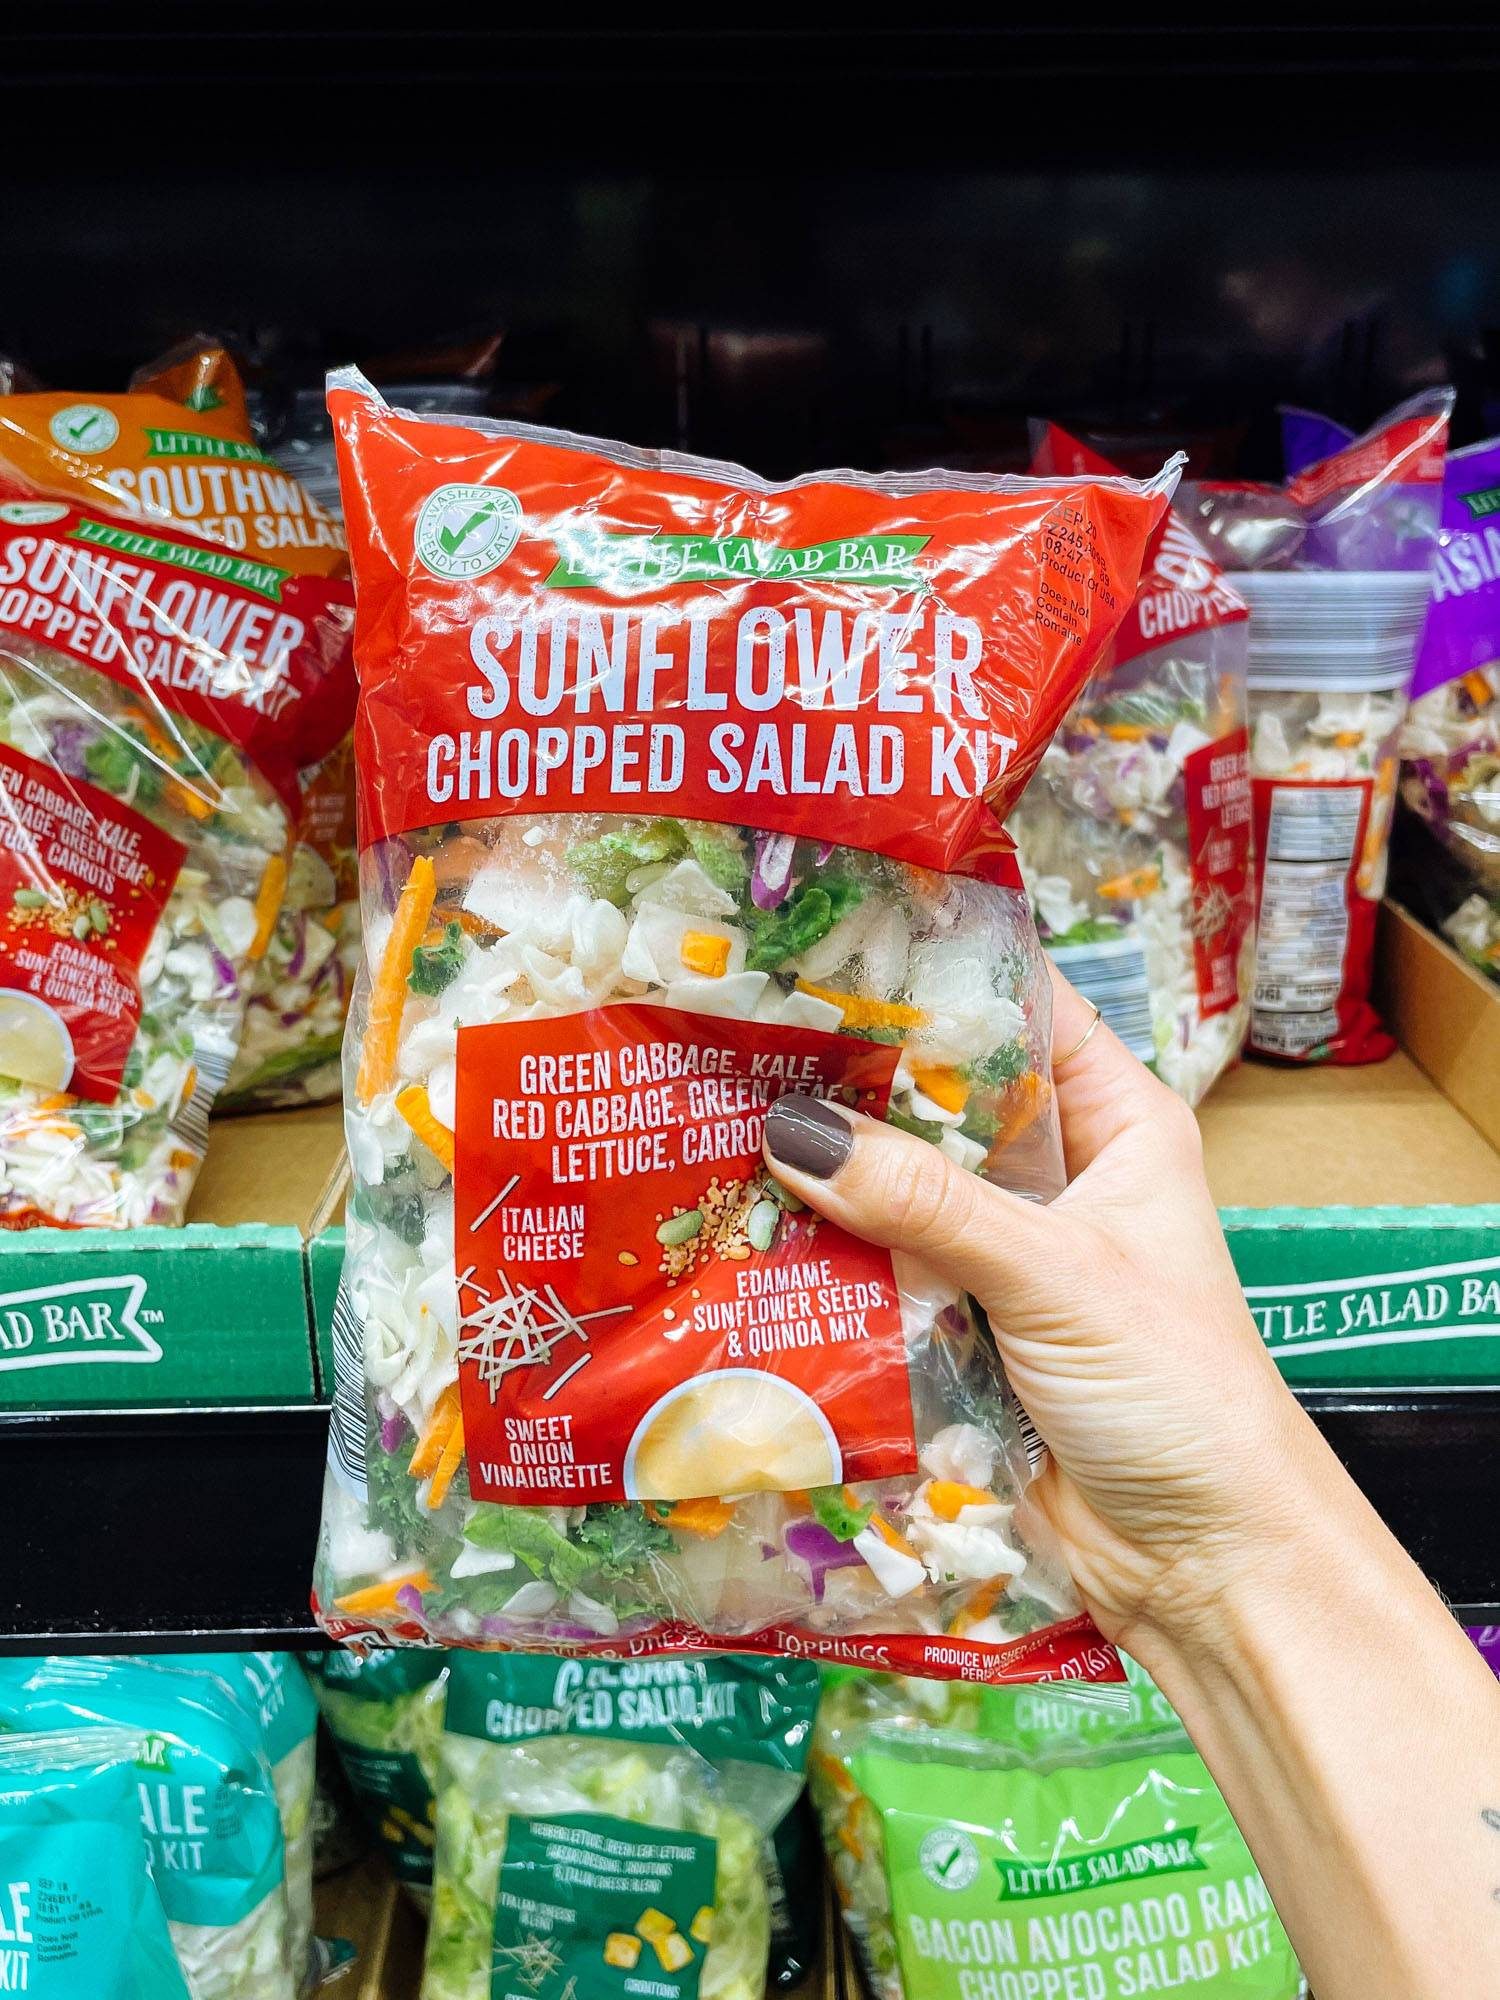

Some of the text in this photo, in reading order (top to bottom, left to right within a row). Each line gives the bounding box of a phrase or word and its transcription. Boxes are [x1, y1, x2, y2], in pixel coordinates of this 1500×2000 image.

[426, 489, 492, 519] WASHED
[80, 523, 158, 558] LITTLE
[164, 545, 233, 576] SALAD
[234, 562, 280, 594] BAR
[422, 531, 511, 572] READY TO EAT
[708, 537, 824, 575] SALAD
[838, 543, 908, 573] BAR
[1040, 552, 1086, 585] Product
[0, 535, 306, 678] SUNFLOWER
[1036, 596, 1078, 628] Contain
[1040, 582, 1090, 620] Does Not
[1034, 610, 1083, 646] Romaine
[466, 605, 991, 722] SUNFLOWER
[426, 723, 1018, 804] CHOPPED SALAD KIT
[97, 817, 143, 859] KALE,
[519, 1041, 824, 1096] GREEN CABBAGE, KALE,
[493, 1097, 545, 1140] RED
[554, 1084, 685, 1139] CABBAGE,
[687, 1077, 769, 1121] GREEN
[551, 1131, 676, 1184] LETTUCE,
[501, 1204, 585, 1235] ITALIAN
[502, 1233, 585, 1262] CHEESE
[736, 1260, 841, 1299] EDAMAME,
[40, 1303, 126, 1343] BAR
[139, 1310, 165, 1324] TM
[693, 1281, 890, 1334] SUNFLOWER SEEDS,
[1335, 1284, 1449, 1336] SALAD
[727, 1312, 870, 1358] & QUINOA MIX
[505, 1415, 573, 1443] SWEET
[509, 1441, 575, 1466] ONION
[480, 1462, 613, 1489] VINAIGRETTE
[775, 1629, 889, 1665] TOPPINGS
[924, 1646, 980, 1668] PRODUCE
[160, 1840, 204, 1871] KIT
[1007, 1863, 1082, 1894] LITTLE
[1086, 1845, 1152, 1884] SALAD
[908, 1912, 1019, 1966] BACON
[1027, 1892, 1191, 1963] AVOCADO
[957, 1919, 1271, 2000] CHOPPED SALAD KIT
